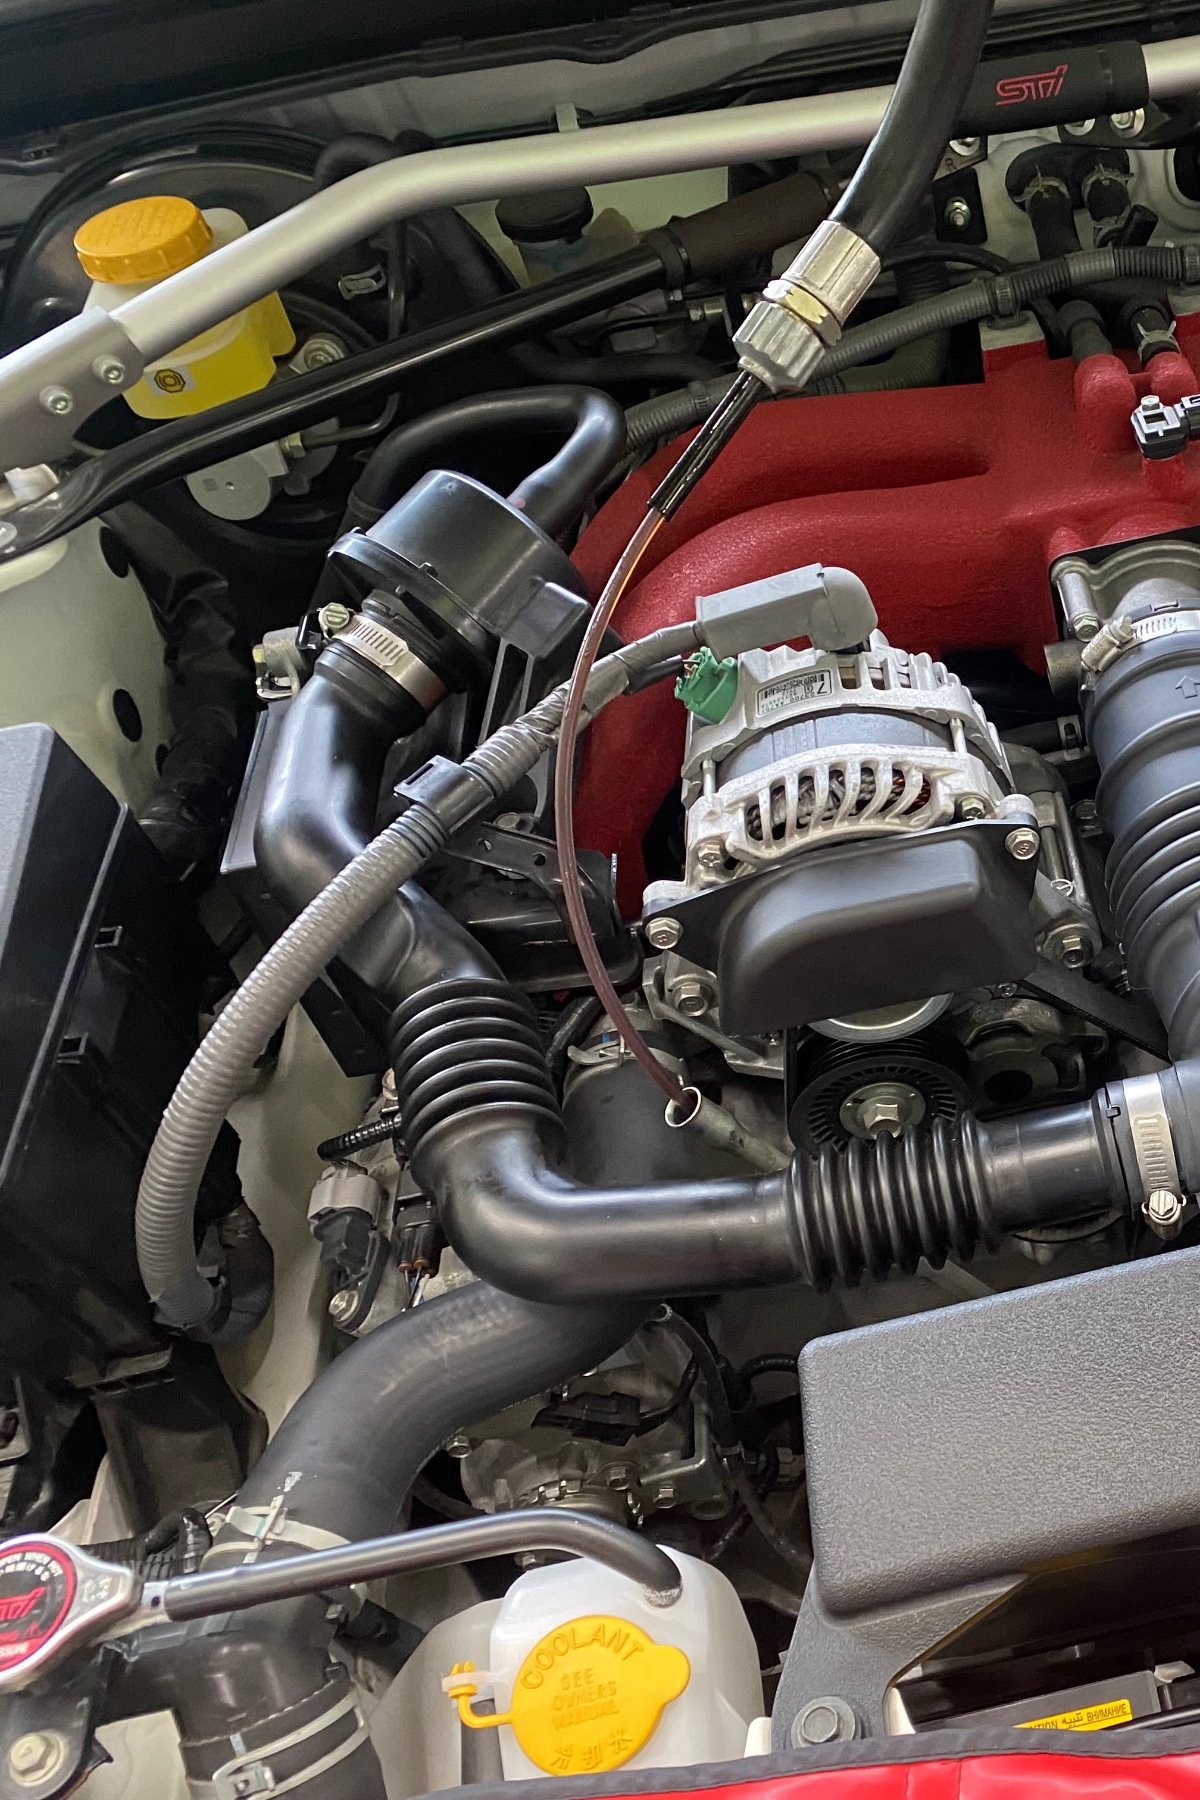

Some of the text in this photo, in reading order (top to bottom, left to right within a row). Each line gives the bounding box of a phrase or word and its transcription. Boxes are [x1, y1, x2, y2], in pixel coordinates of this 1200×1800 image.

[24, 1551, 50, 1565] WHEN
[521, 1623, 645, 1690] COOLANT
[560, 1667, 595, 1691] SEE
[1086, 1703, 1127, 1722] ВНИМАНИЕ
